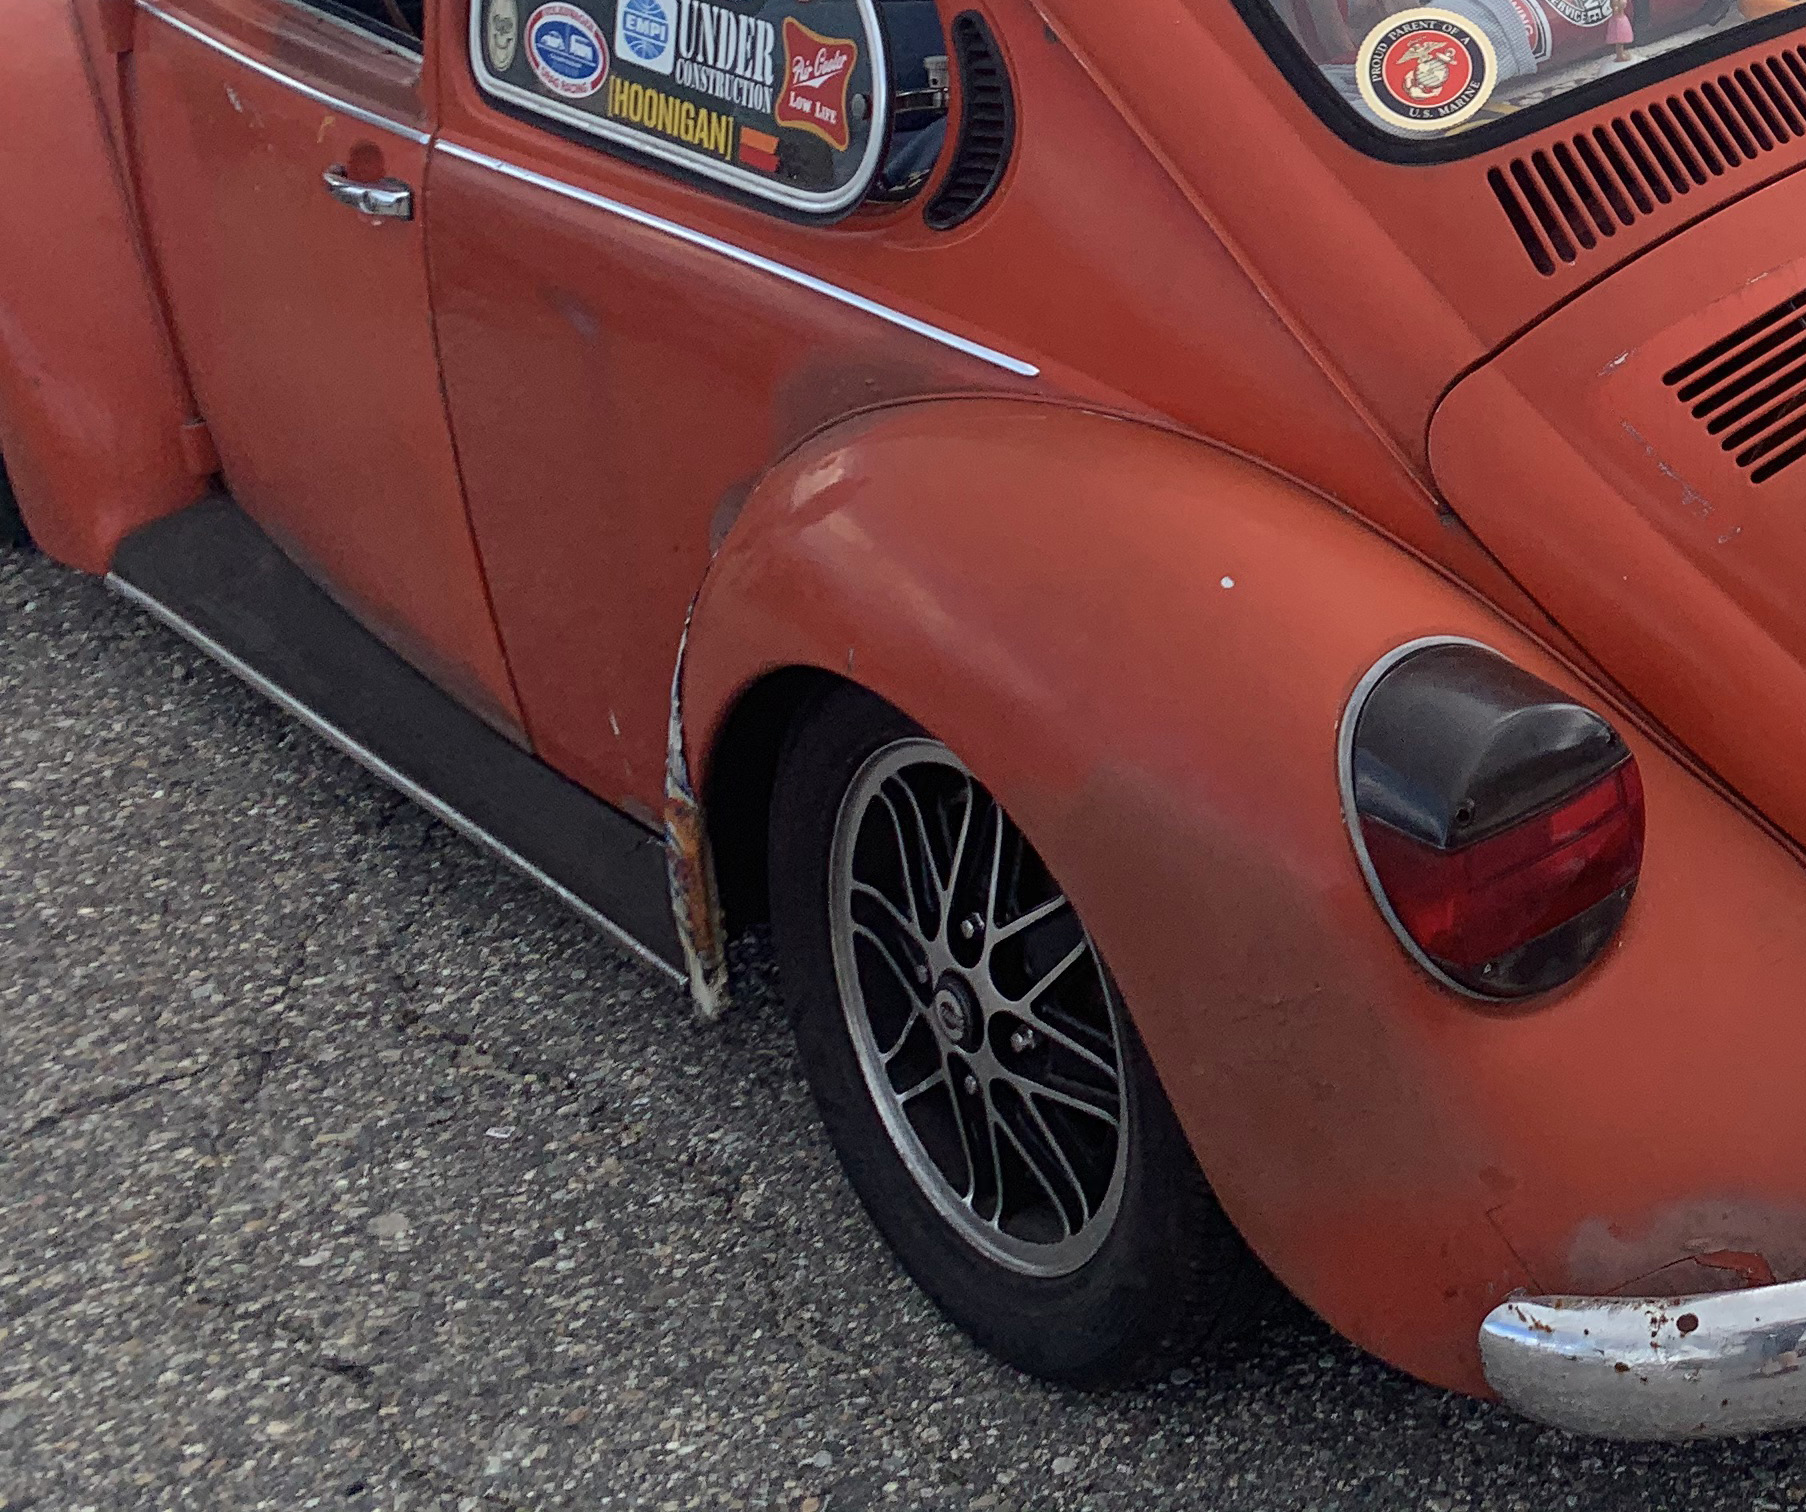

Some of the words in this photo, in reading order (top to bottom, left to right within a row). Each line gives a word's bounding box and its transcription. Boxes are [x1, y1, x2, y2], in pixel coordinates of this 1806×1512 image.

[625, 12, 667, 38] EMPI
[1372, 42, 1388, 82] PROUD
[1389, 20, 1438, 41] PARENT
[1441, 22, 1458, 36] OF
[1461, 35, 1471, 45] A
[675, 57, 774, 114] CONSTRUCTION
[1408, 106, 1434, 119] U.S.
[1438, 80, 1480, 119] MARINE
